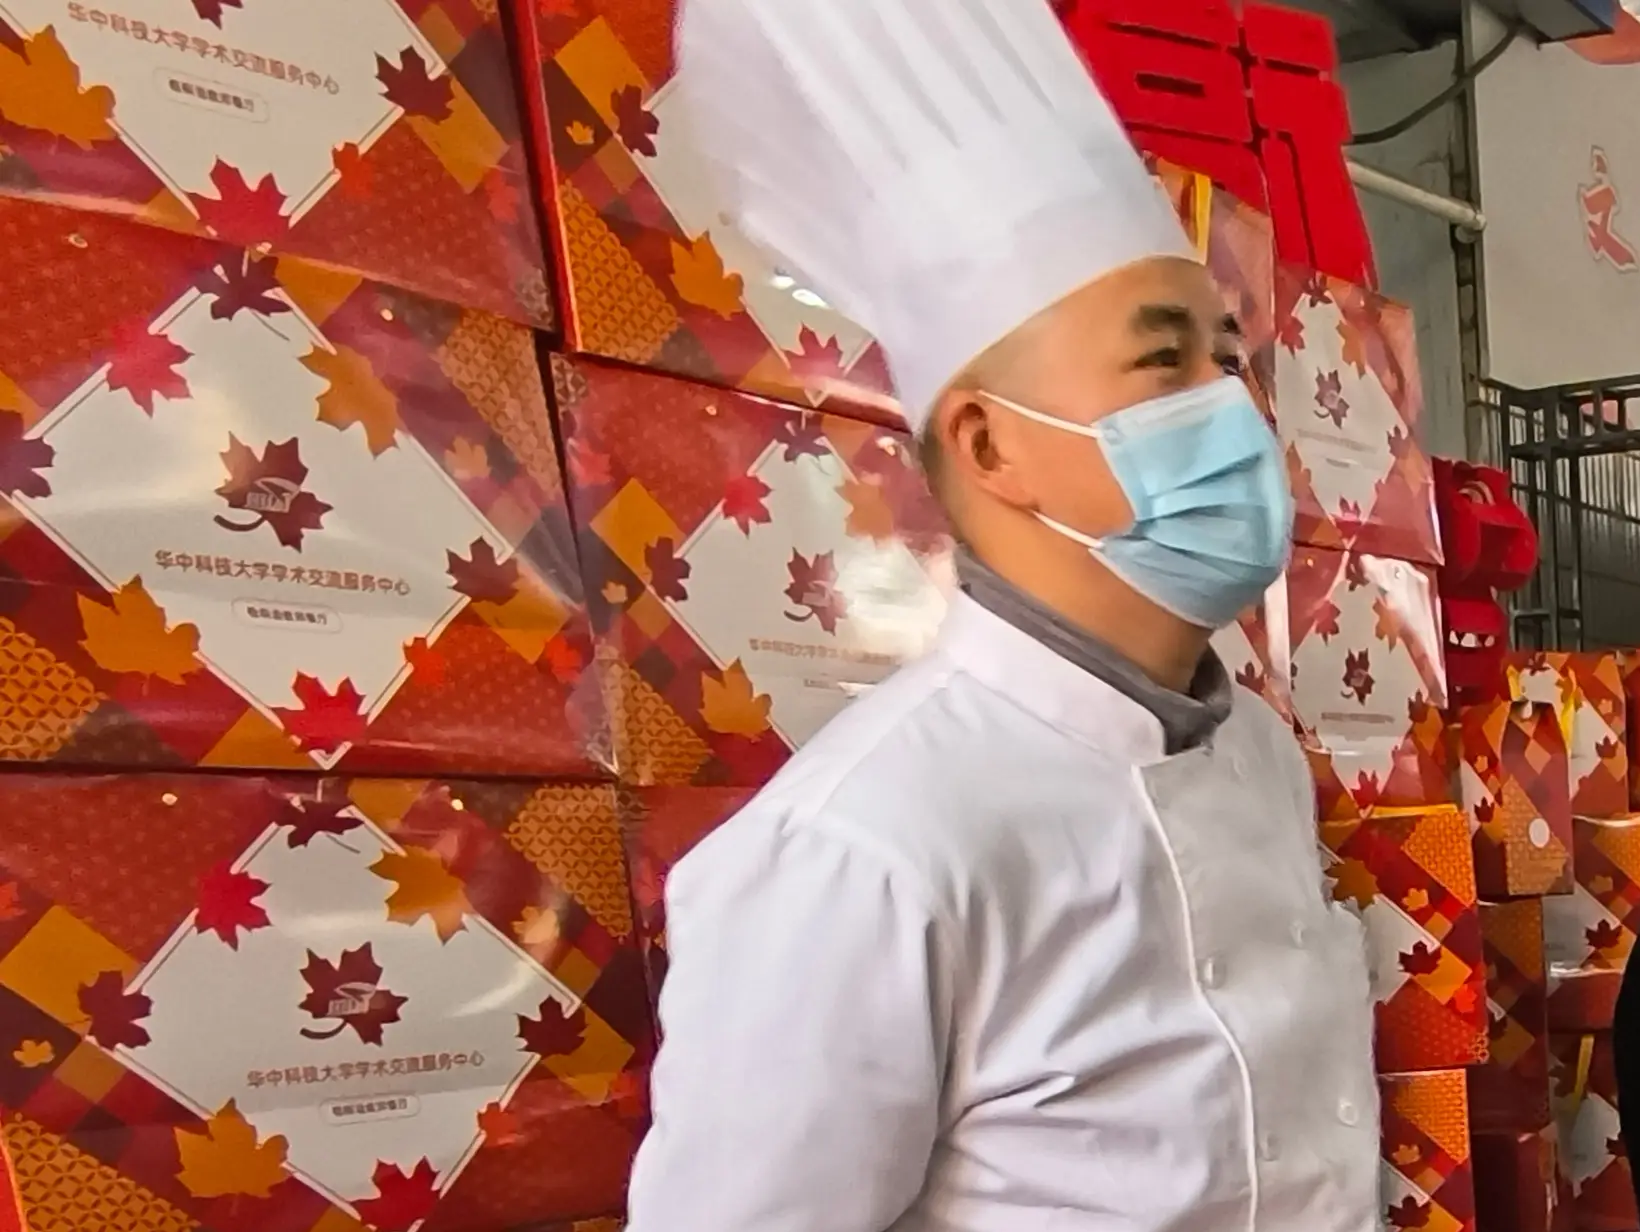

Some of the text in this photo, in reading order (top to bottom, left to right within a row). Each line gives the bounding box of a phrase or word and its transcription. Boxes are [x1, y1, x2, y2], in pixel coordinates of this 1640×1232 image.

[153, 548, 412, 597] 华中科技大学学术交流服务中心
[246, 1050, 486, 1088] 华中科技大学学术交流服务中心
